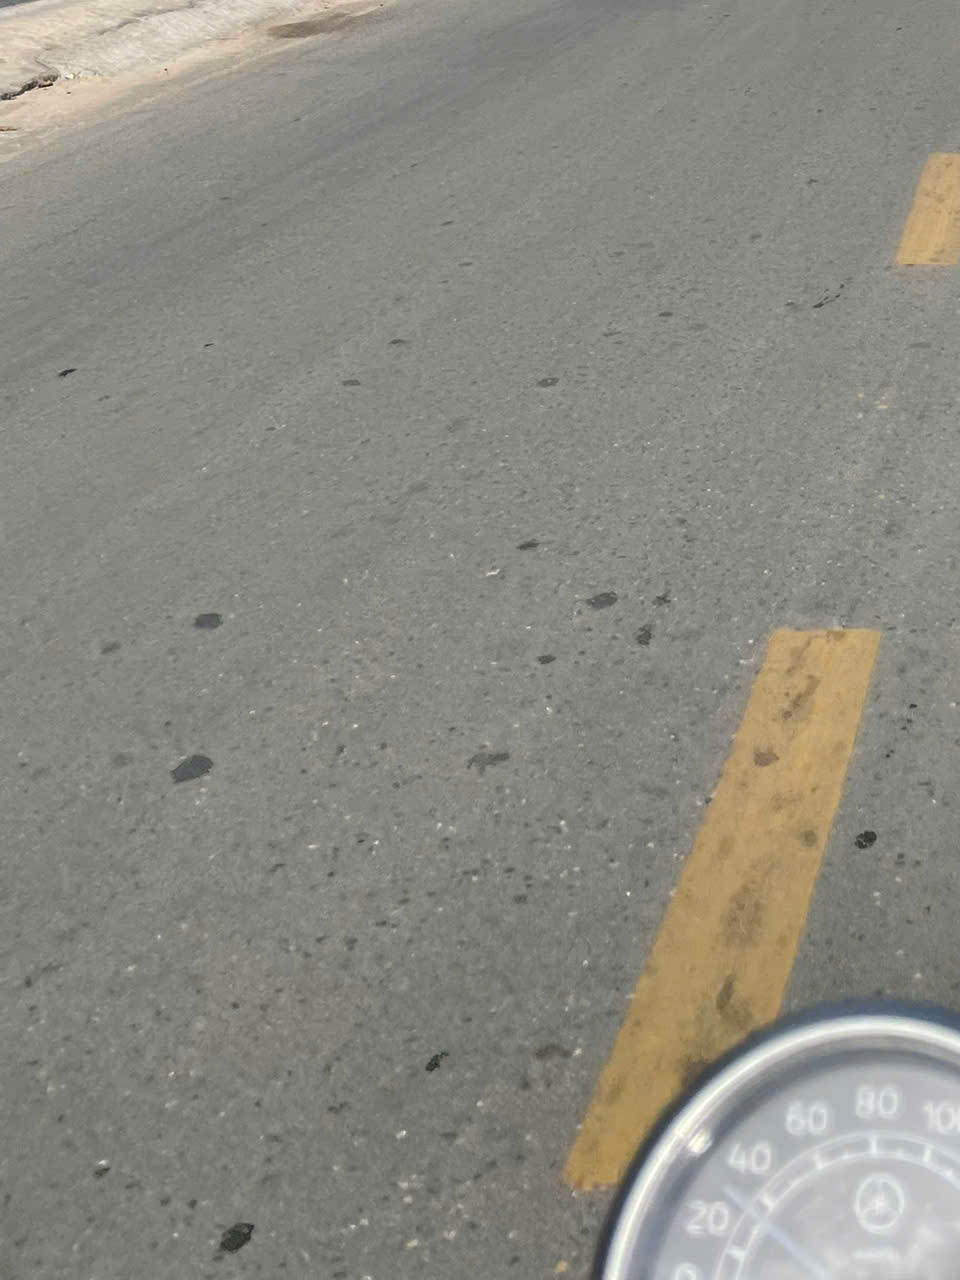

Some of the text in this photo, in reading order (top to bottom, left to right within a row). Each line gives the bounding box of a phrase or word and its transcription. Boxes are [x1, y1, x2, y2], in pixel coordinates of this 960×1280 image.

[855, 1087, 899, 1119] 80
[785, 1105, 828, 1135] 60
[728, 1142, 772, 1174] 40
[685, 1202, 729, 1236] 20
